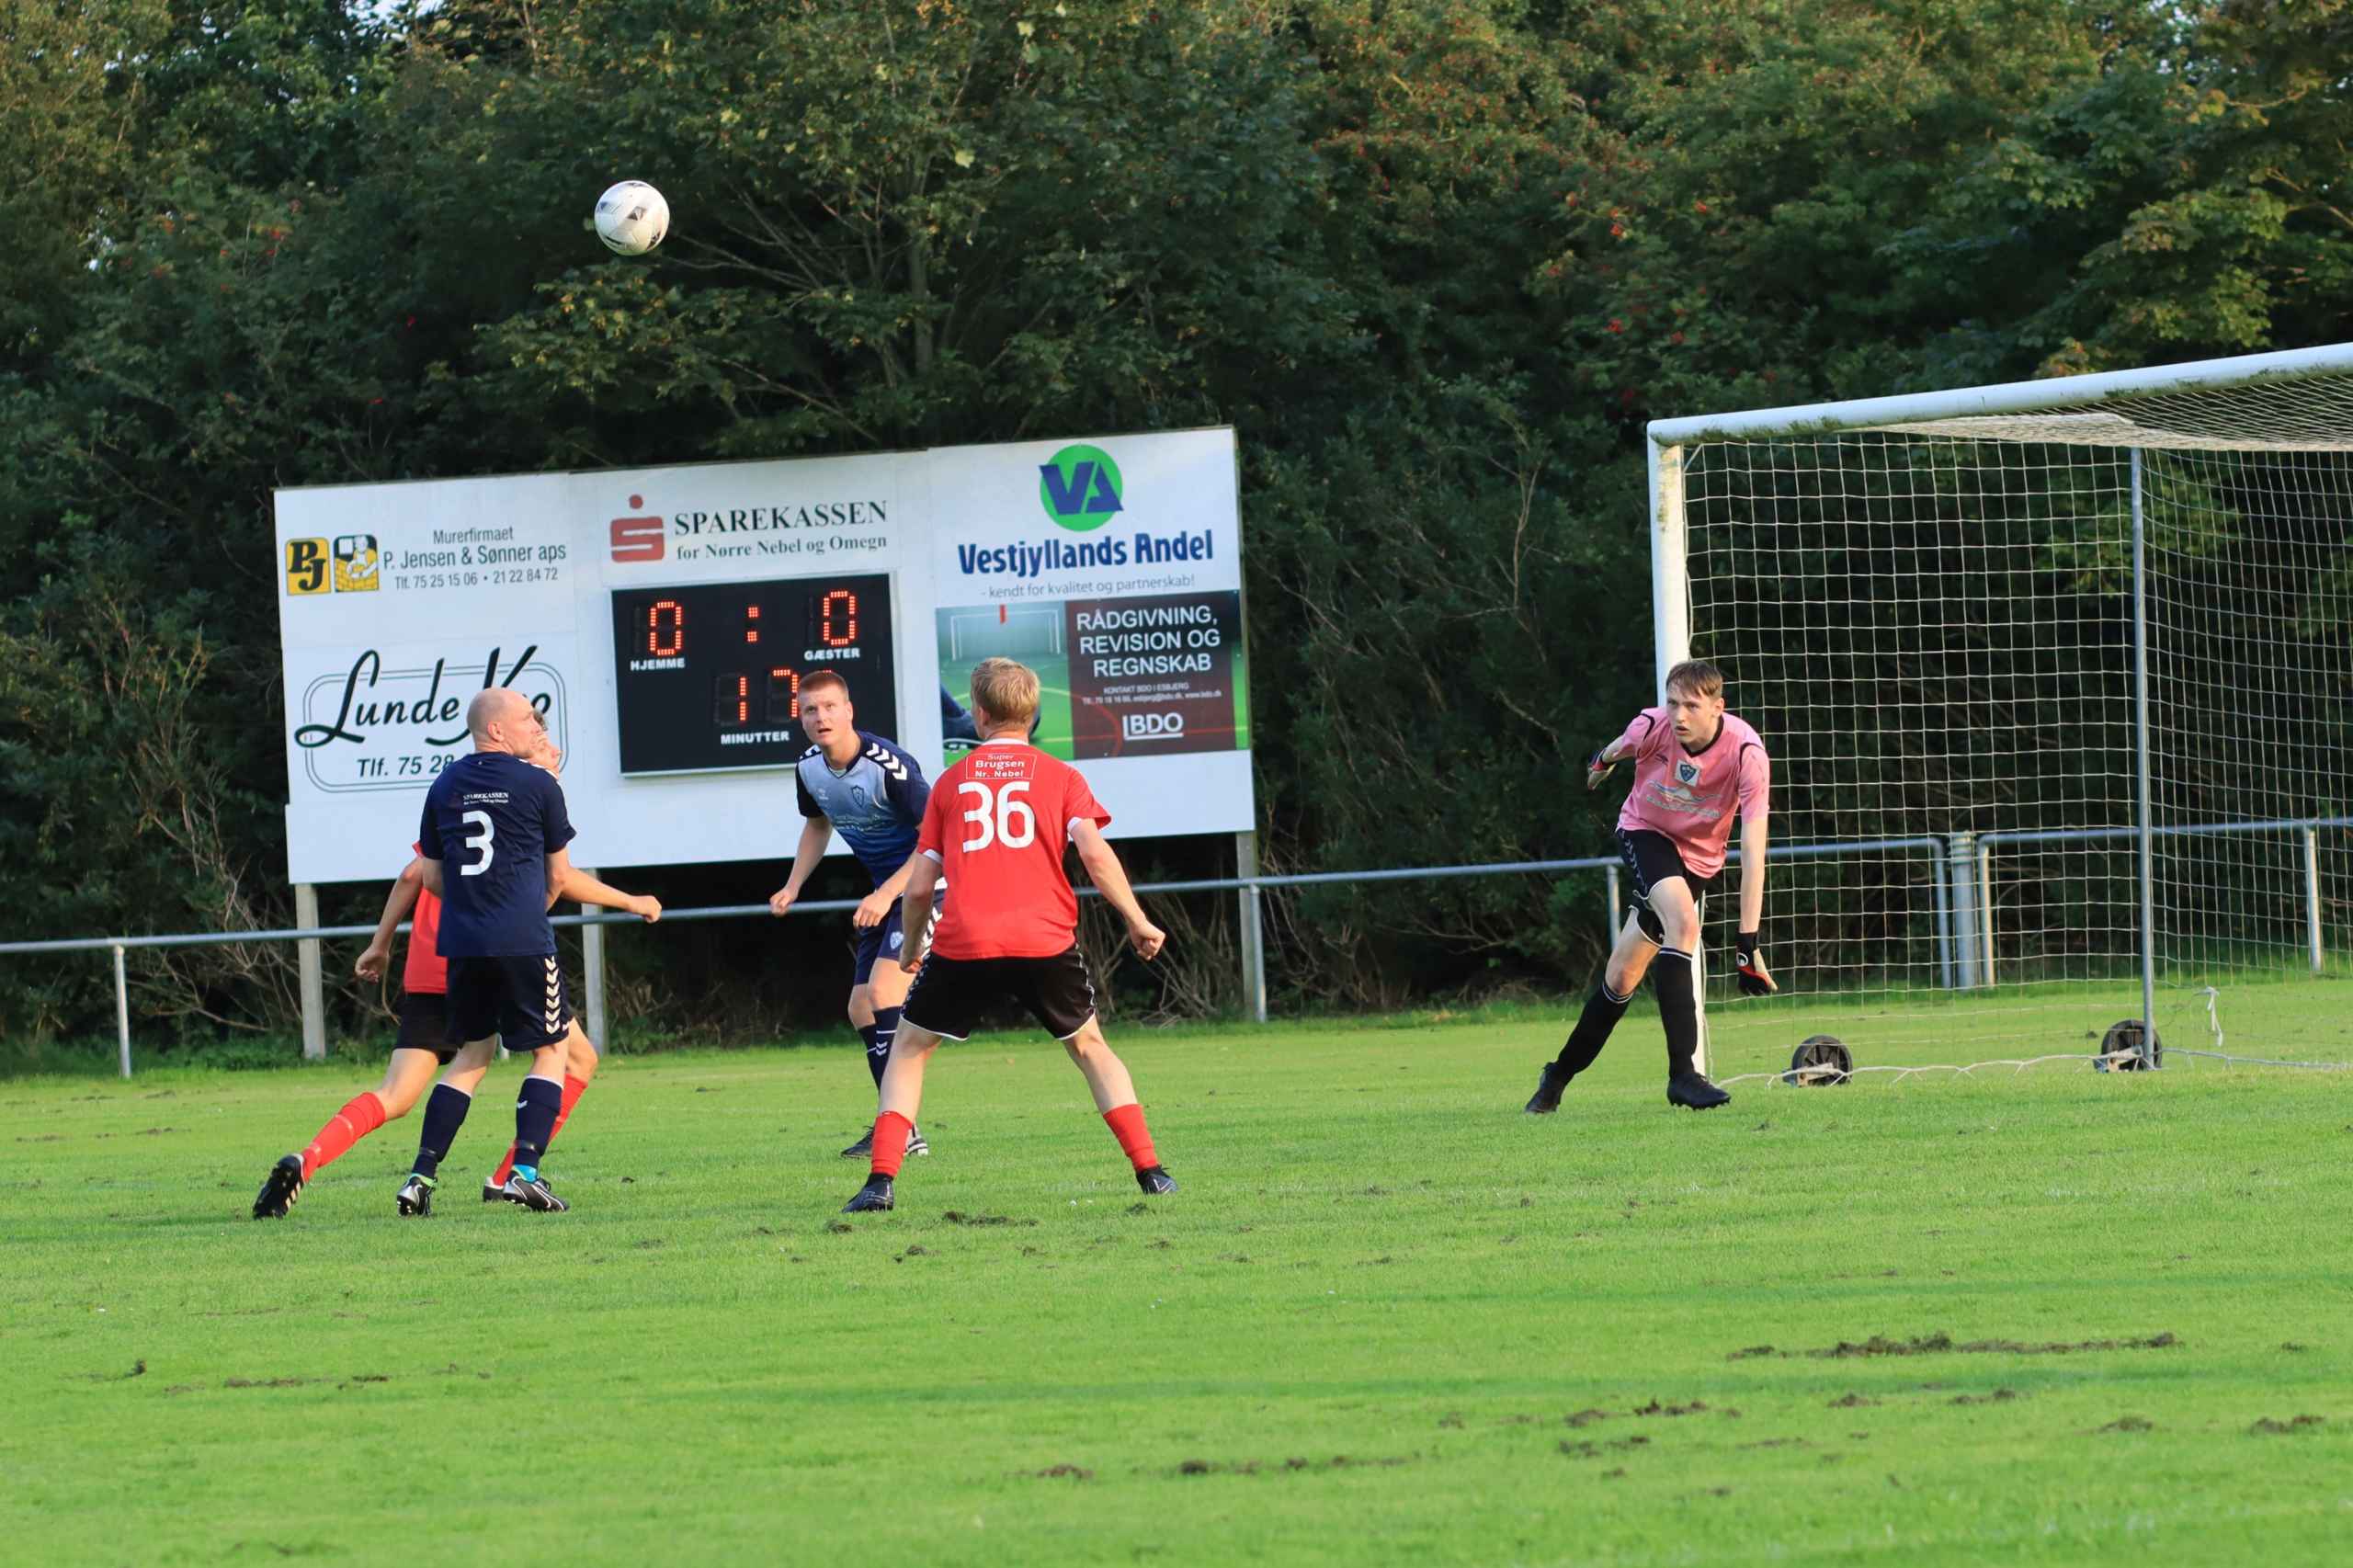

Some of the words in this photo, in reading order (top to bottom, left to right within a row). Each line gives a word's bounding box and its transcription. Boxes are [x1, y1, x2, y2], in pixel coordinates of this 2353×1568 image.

[675, 499, 888, 537] SPAREKASSEN
[433, 526, 514, 546] Murerfirmaet
[676, 545, 699, 561] for
[757, 538, 801, 555] Nebel
[806, 540, 825, 554] og
[830, 534, 888, 551] Omegn
[383, 551, 395, 571] P.
[400, 551, 456, 570] Jensen
[460, 547, 472, 565] &
[477, 545, 533, 564] Sønner
[538, 544, 567, 563] aps
[958, 535, 1128, 577] Vestjyllands
[1134, 529, 1213, 564] Andel
[395, 576, 411, 590] Tlf.
[413, 574, 427, 589] 75
[430, 574, 445, 588] 25
[449, 573, 460, 587] 15
[463, 572, 478, 586] 06
[493, 570, 506, 585] 21
[509, 569, 523, 584] 22
[526, 568, 541, 583] 84
[545, 567, 559, 581] 72
[989, 585, 1025, 599] kendt
[1027, 584, 1044, 597] for
[1048, 580, 1094, 597] kvalitet
[1097, 582, 1114, 595] og
[1116, 574, 1195, 592] partnerskab!
[649, 600, 682, 655] 0
[823, 591, 856, 645] 0
[1076, 604, 1218, 631] RÅDGIVNING,
[803, 647, 860, 662] GÆSTER
[1080, 631, 1181, 655] REVISION
[1188, 628, 1221, 648] OG
[630, 657, 686, 672] HJEMME
[1093, 652, 1211, 678] REGNSKAB
[294, 649, 460, 748] Lunde
[721, 730, 790, 745] MINUTTER
[357, 758, 389, 778] Tlf.
[399, 756, 423, 776] 75
[975, 759, 1025, 770] Brugsen
[994, 769, 1024, 778] Nebel
[958, 781, 1036, 853] 36
[460, 810, 494, 876] 3
